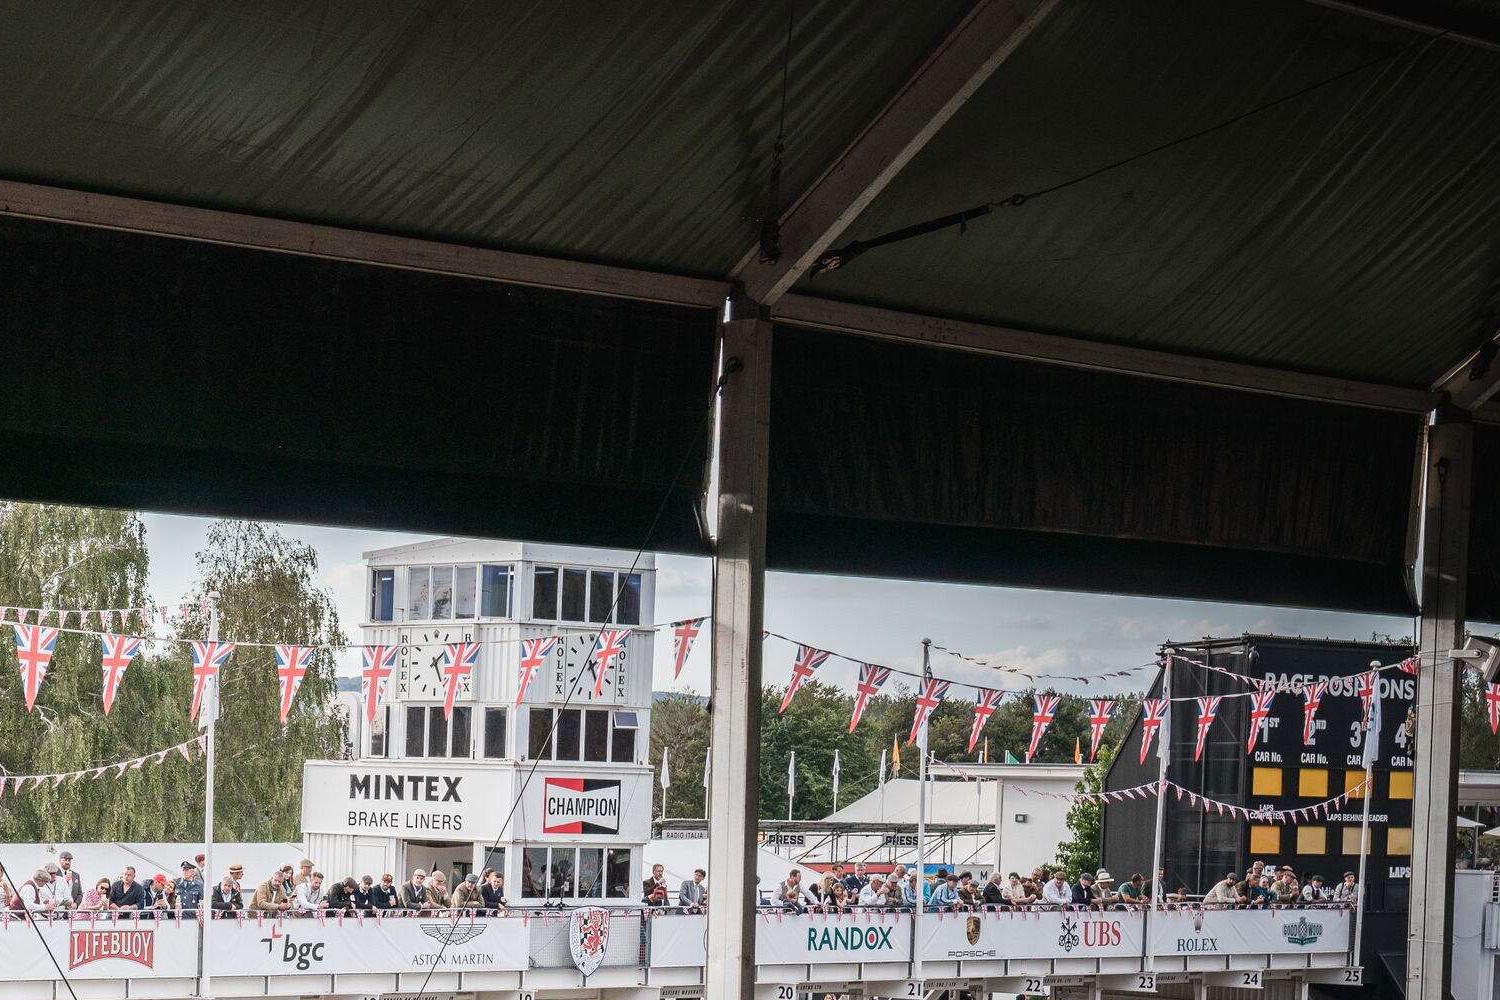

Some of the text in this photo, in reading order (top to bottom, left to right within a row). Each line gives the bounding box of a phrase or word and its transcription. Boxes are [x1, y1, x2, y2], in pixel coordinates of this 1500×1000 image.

[400, 635, 408, 692] ROLEX
[555, 636, 564, 694] ROLEX
[1255, 752, 1270, 763] CAR
[1301, 753, 1315, 764] CAR
[1391, 756, 1406, 766] CAR
[349, 774, 463, 803] MINTEX
[548, 797, 617, 817] CHAMPION
[348, 811, 462, 831] BRAKE LINERS
[768, 833, 804, 845] PRESS
[885, 835, 918, 846] PRESS
[808, 926, 893, 951] RANDOX
[1083, 920, 1121, 947] UBS
[72, 932, 153, 965] LIFEBUOY
[1177, 938, 1218, 952] ROLEX
[282, 934, 325, 970] bgc
[411, 953, 494, 965] ASTON MARTIN
[1139, 976, 1154, 989] 23
[1243, 973, 1258, 985] 24
[1345, 970, 1359, 982] 25
[908, 983, 921, 996] 21
[1025, 979, 1040, 992] 22
[778, 986, 793, 999] 20
